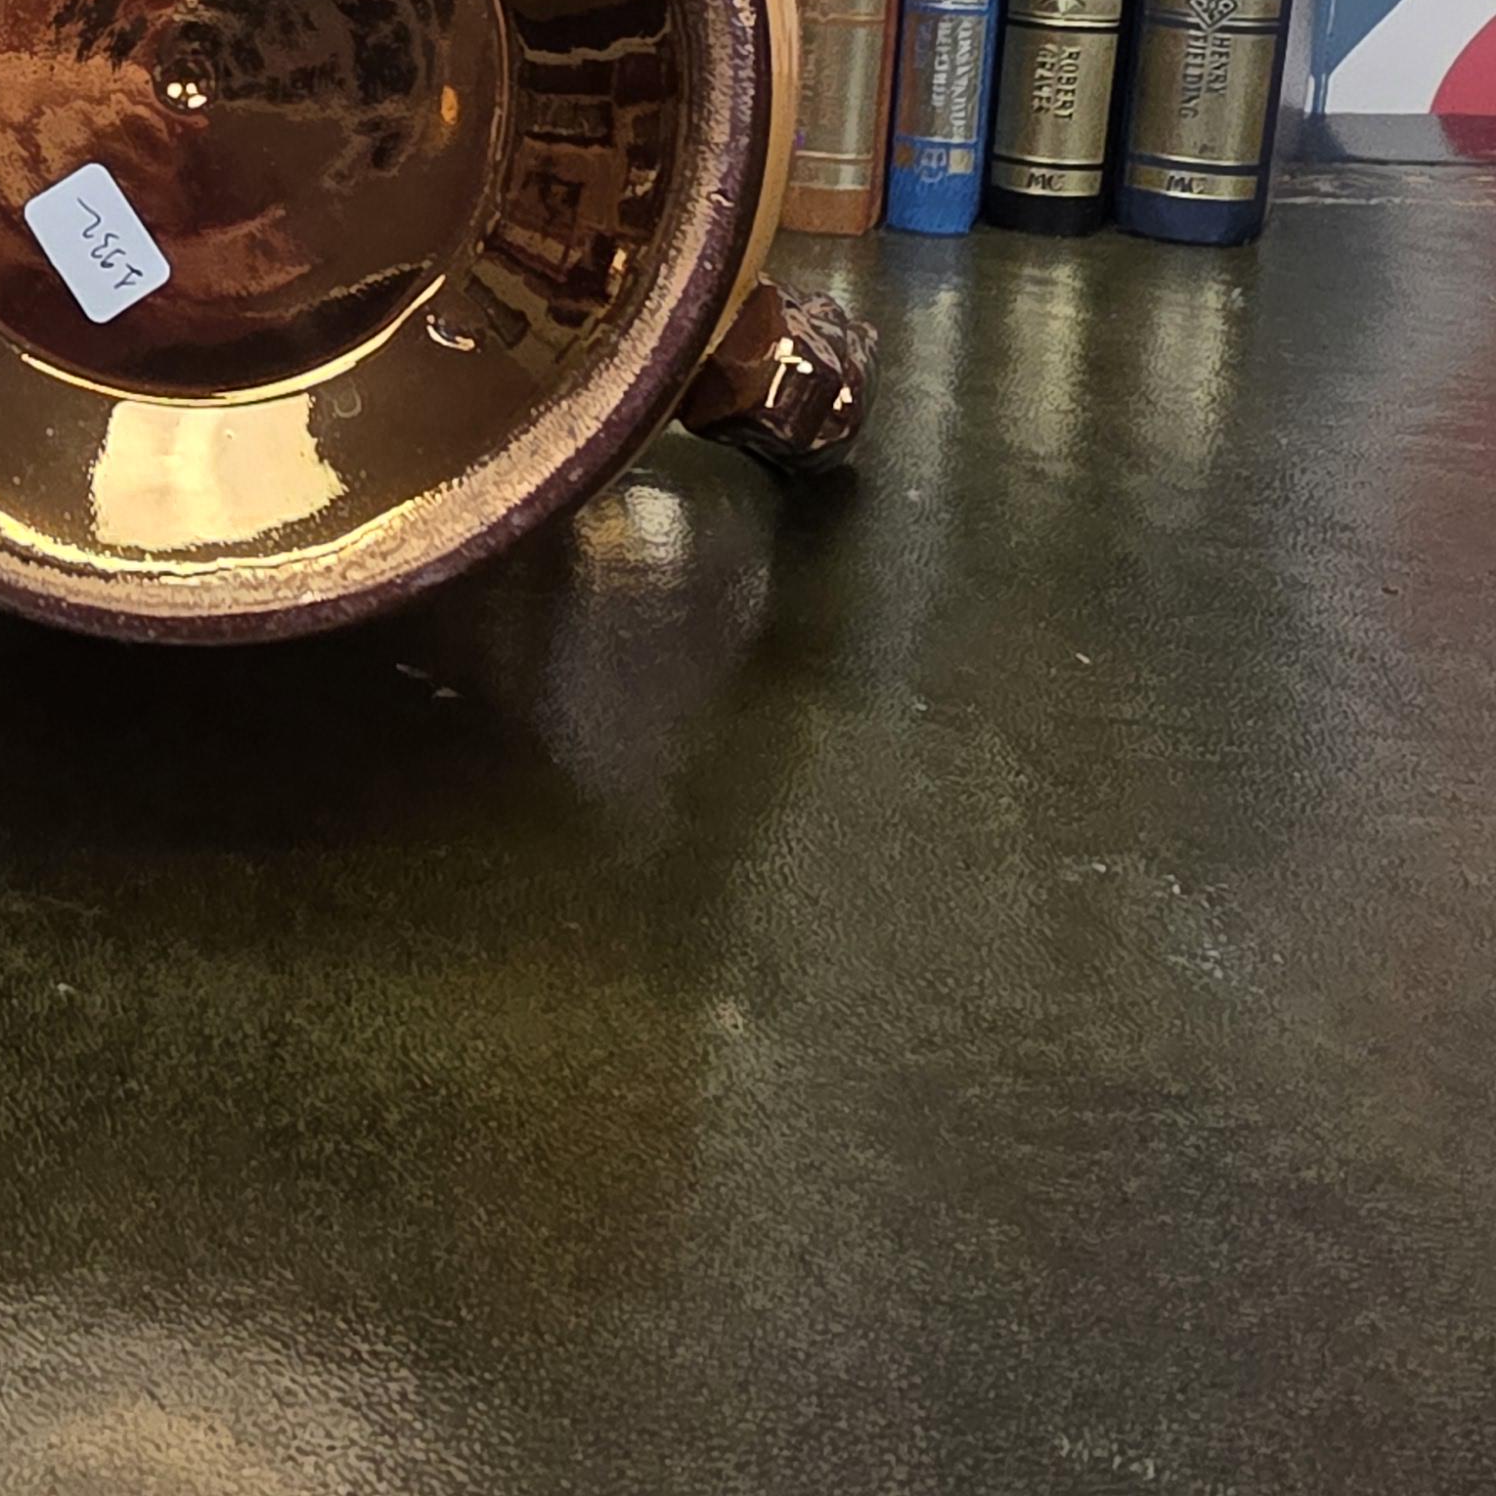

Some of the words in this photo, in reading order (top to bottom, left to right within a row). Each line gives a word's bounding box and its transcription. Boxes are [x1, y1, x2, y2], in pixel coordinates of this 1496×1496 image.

[1054, 45, 1081, 121] ROBERT
[1179, 28, 1209, 120] FIELDING
[1204, 30, 1232, 99] HENRY
